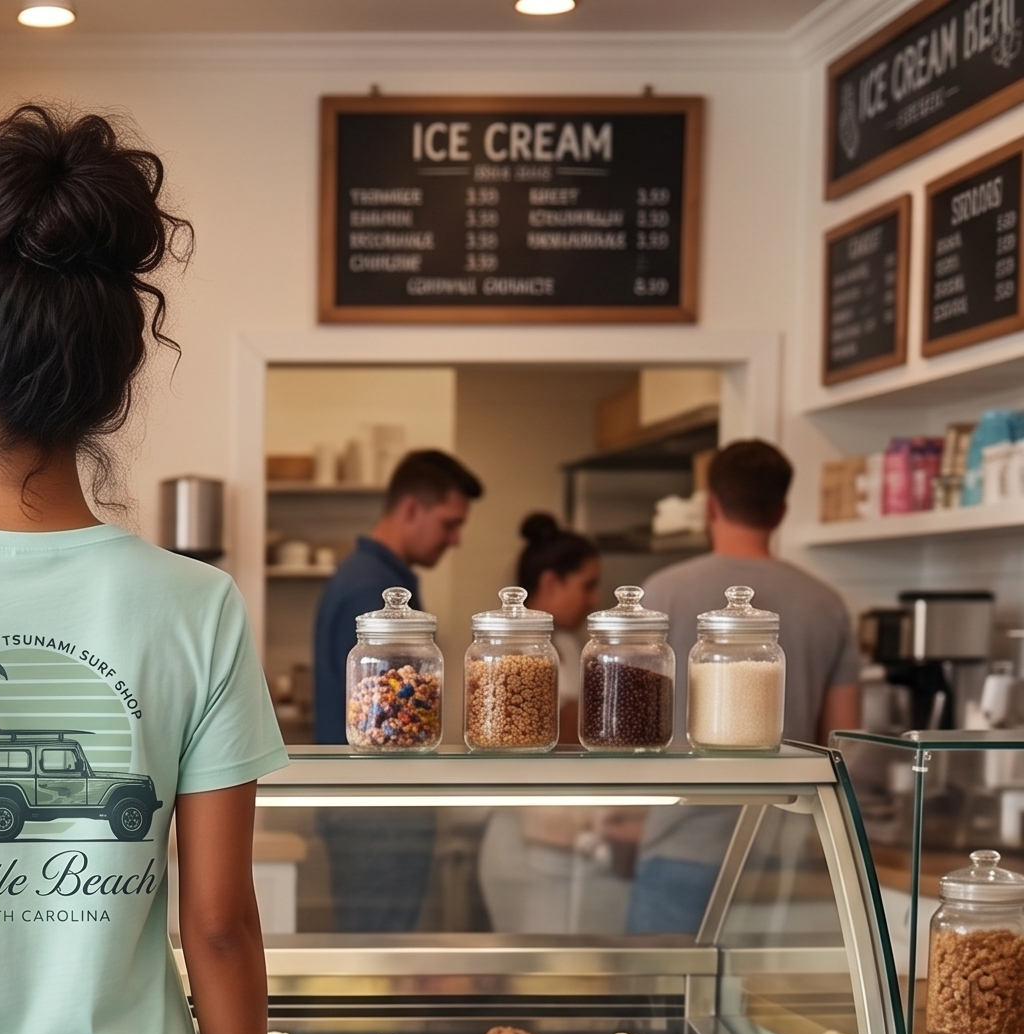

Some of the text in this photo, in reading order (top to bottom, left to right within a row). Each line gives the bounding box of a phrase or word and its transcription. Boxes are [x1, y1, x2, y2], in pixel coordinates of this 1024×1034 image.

[859, 61, 888, 123] ICE
[890, 16, 958, 102] CREAM
[412, 122, 614, 162] ICE CREAM
[2, 634, 143, 720] TSUNAMI SURF SHOP
[35, 849, 158, 897] Beach
[21, 910, 111, 922] CAROLINA
